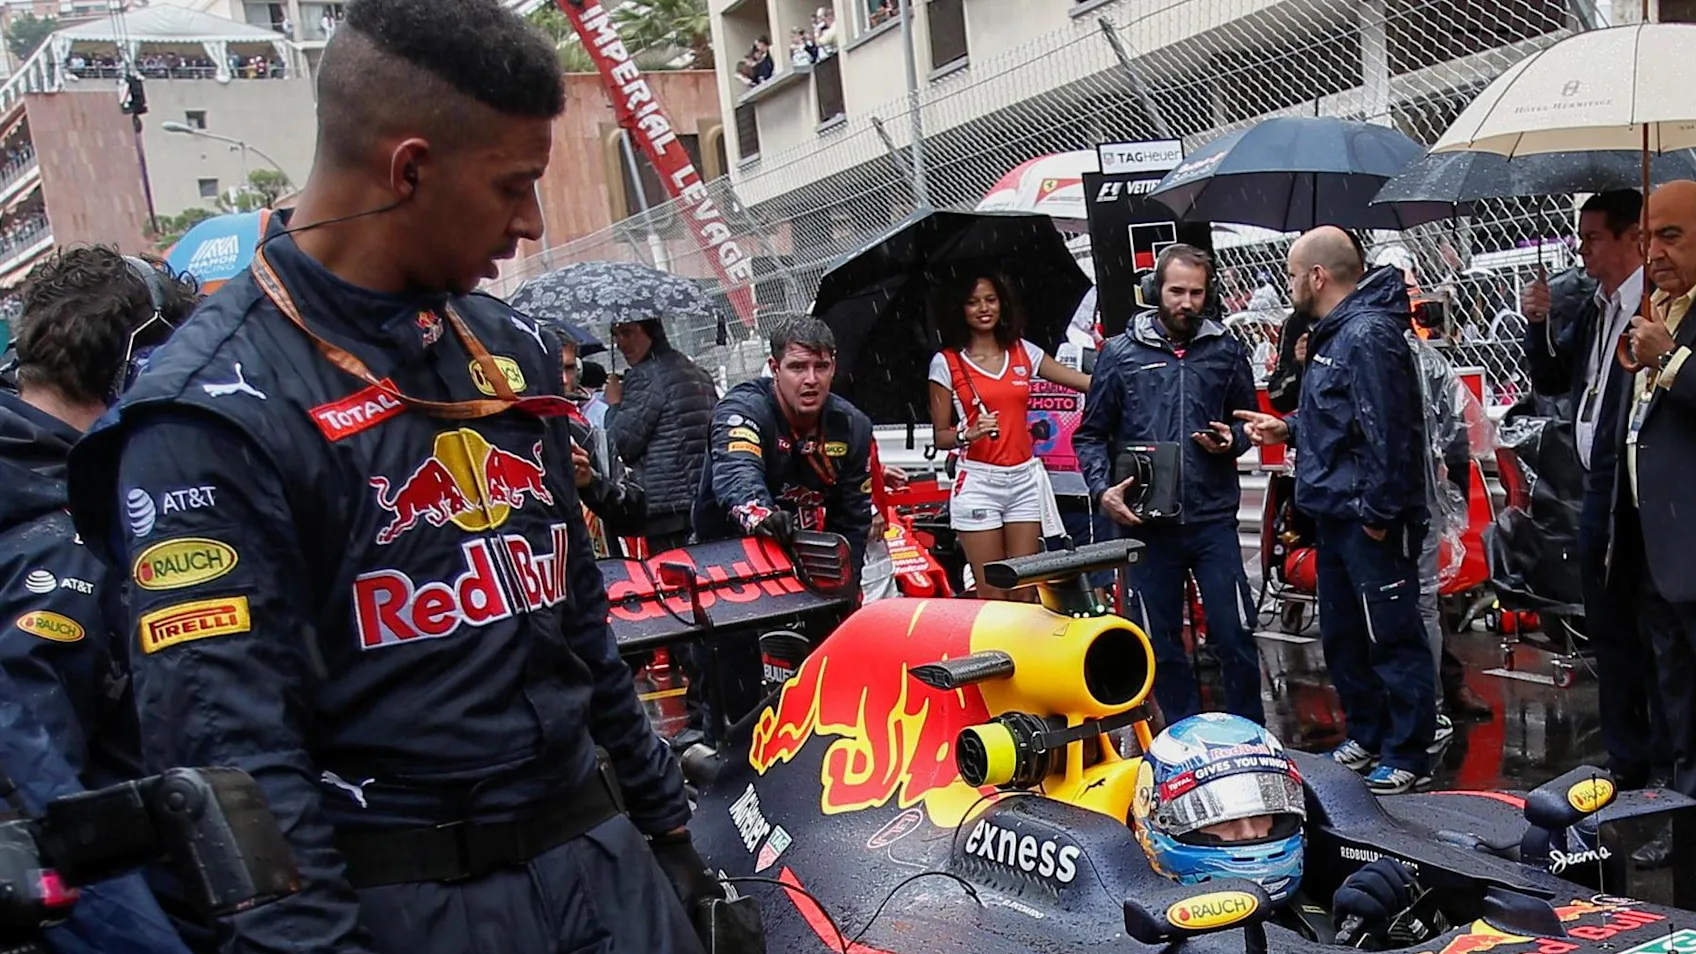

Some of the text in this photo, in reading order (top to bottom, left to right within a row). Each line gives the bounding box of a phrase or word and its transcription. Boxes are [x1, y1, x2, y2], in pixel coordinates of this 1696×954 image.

[579, 4, 751, 285] IMPERIAL LEVAGE
[1126, 179, 1161, 195] VETTE
[319, 393, 400, 430] TOTAL
[163, 486, 216, 514] AT&T
[152, 550, 223, 577] RAUCH
[60, 577, 94, 594] AT&T
[353, 538, 513, 650] Red
[503, 523, 567, 613] Bull
[34, 616, 77, 637] RAUCH
[150, 605, 238, 644] PIRELLI
[1195, 761, 1231, 779] GIVES
[1233, 757, 1258, 768] YOU
[1168, 777, 1192, 792] TOTAL
[965, 819, 1080, 882] exness
[1549, 846, 1611, 874] Jeans
[1191, 899, 1247, 919] RAUCH
[1567, 910, 1667, 940] Bull
